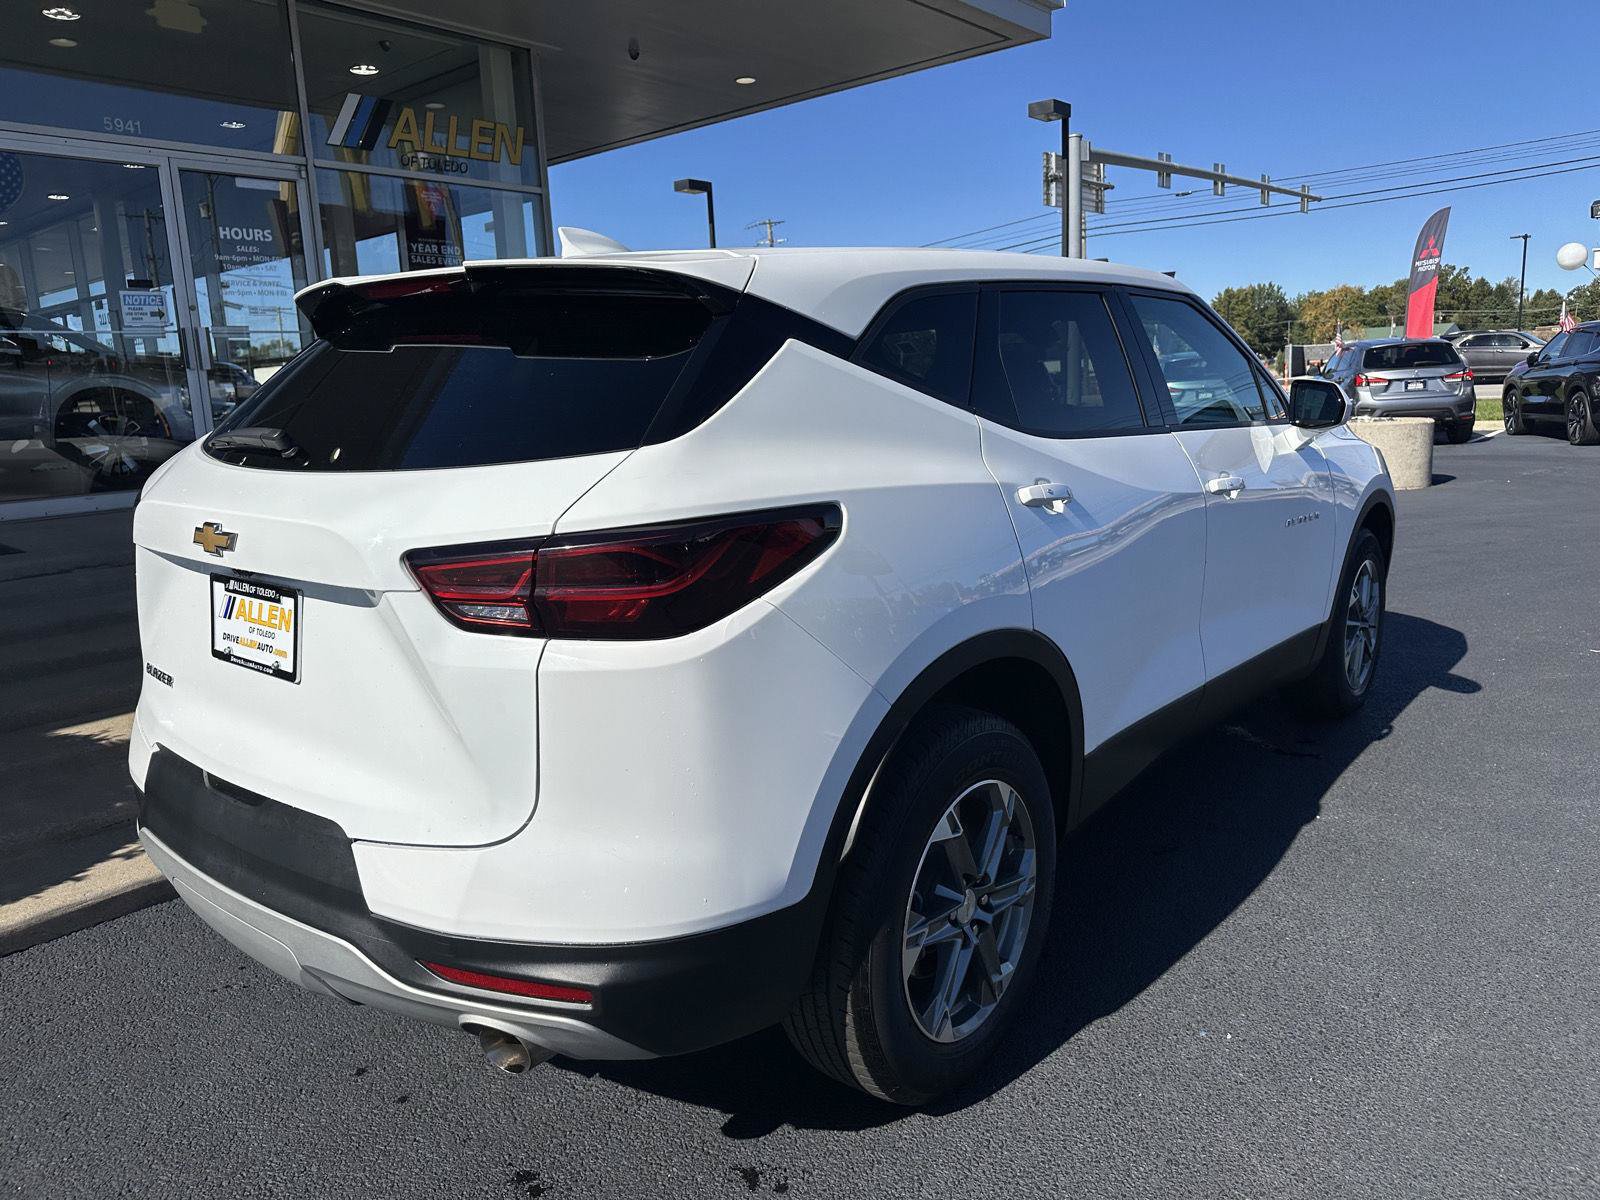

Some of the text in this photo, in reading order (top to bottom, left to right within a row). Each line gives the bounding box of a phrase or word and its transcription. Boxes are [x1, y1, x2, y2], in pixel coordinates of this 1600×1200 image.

[103, 116, 142, 135] 5941
[387, 106, 525, 166] ALLEN
[400, 154, 469, 174] OF TOLEDO
[219, 226, 273, 242] HOURS
[236, 245, 260, 253] SALES:
[410, 242, 461, 256] YEAR END
[411, 255, 437, 265] SALES
[125, 295, 163, 305] NOTICE
[233, 580, 276, 598] ALLEN OF TOLEDO
[235, 598, 292, 632] ALLEN
[248, 626, 276, 640] OF TOLEDO
